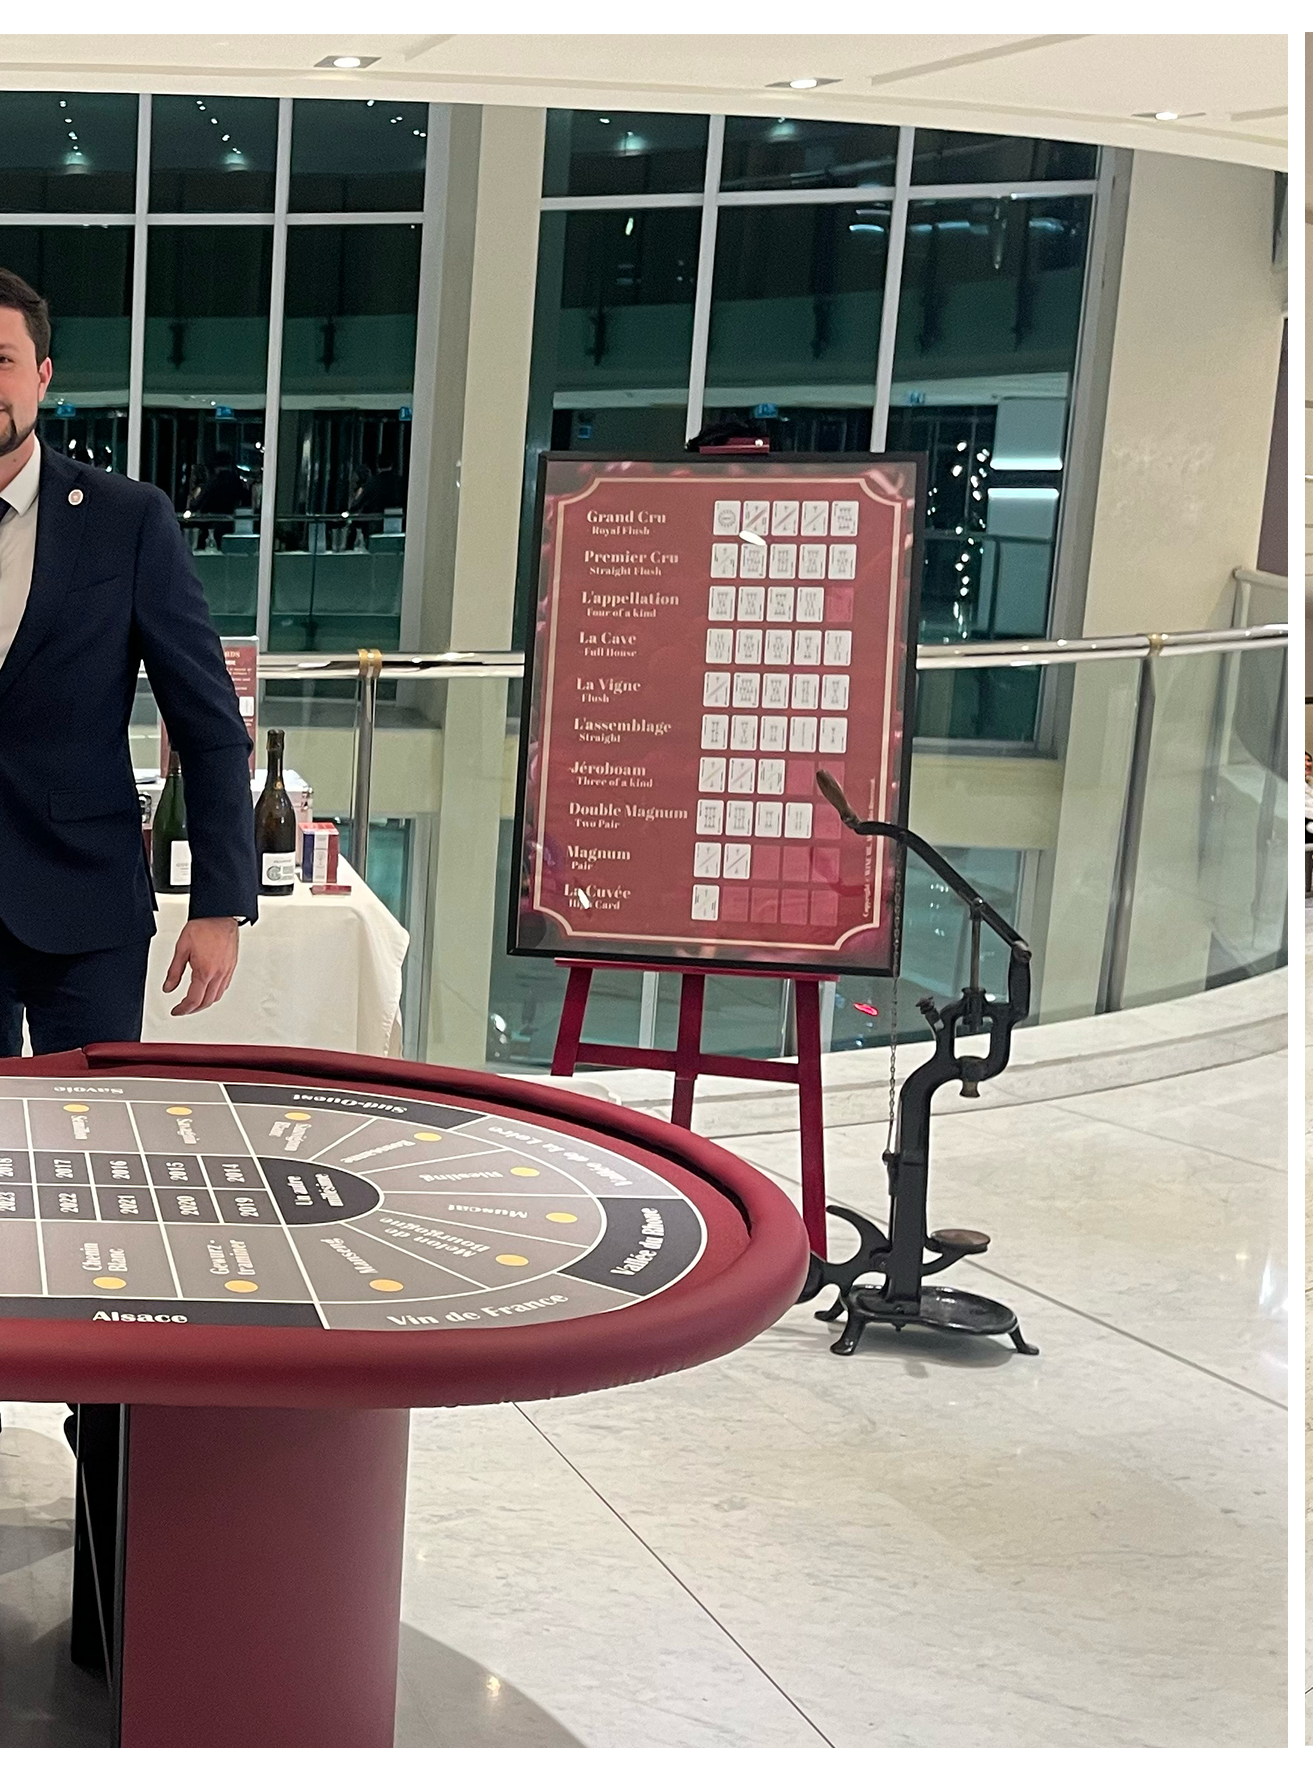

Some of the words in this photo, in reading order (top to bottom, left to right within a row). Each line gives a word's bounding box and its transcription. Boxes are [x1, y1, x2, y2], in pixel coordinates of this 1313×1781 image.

[587, 510, 634, 524] Grand
[638, 512, 666, 524] Cru
[592, 526, 620, 537] Royal
[622, 527, 650, 535] Flush
[584, 550, 648, 564] Premier
[650, 551, 679, 564] Cru
[589, 567, 631, 577] Straight
[634, 567, 662, 576] Flush
[582, 591, 679, 608] L'appellation
[632, 609, 657, 618] kind
[579, 631, 597, 644] La
[601, 632, 636, 645] Cave
[577, 678, 594, 691] La
[598, 678, 641, 694] Vigne
[574, 718, 671, 735] L'assemblage
[579, 734, 621, 744] Straight
[570, 761, 646, 776] Jéroboam
[576, 777, 607, 787] Three
[629, 778, 653, 788] kind
[569, 802, 621, 817] Double
[626, 804, 688, 822] Magnum
[575, 819, 596, 828] Two
[598, 819, 620, 829] Pair
[567, 845, 630, 862] Magnum
[572, 861, 593, 870] Pair
[586, 884, 631, 899] Cuvée
[595, 900, 620, 910] Card
[54, 1087, 124, 1095] Savoie
[293, 1094, 408, 1114] Sud-Ouest
[488, 1125, 543, 1145] Loire
[54, 1159, 74, 1179] 2017
[110, 1161, 130, 1180] 2016
[166, 1162, 188, 1181] 2015
[419, 1171, 503, 1183] Riesling
[58, 1193, 79, 1213] 2022
[117, 1195, 138, 1215] 2021
[177, 1196, 199, 1216] 2020
[235, 1197, 259, 1218] 2019
[448, 1204, 528, 1219] Muscat
[379, 1217, 490, 1254] Bourgogne
[384, 1228, 410, 1238] de
[413, 1237, 477, 1259] Melon
[108, 1248, 128, 1272] Blanc
[611, 1248, 656, 1277] Vallée
[639, 1237, 663, 1251] du
[92, 1310, 188, 1324] Alsace
[387, 1313, 439, 1327] Vin
[445, 1309, 479, 1324] de
[480, 1293, 568, 1318] France
